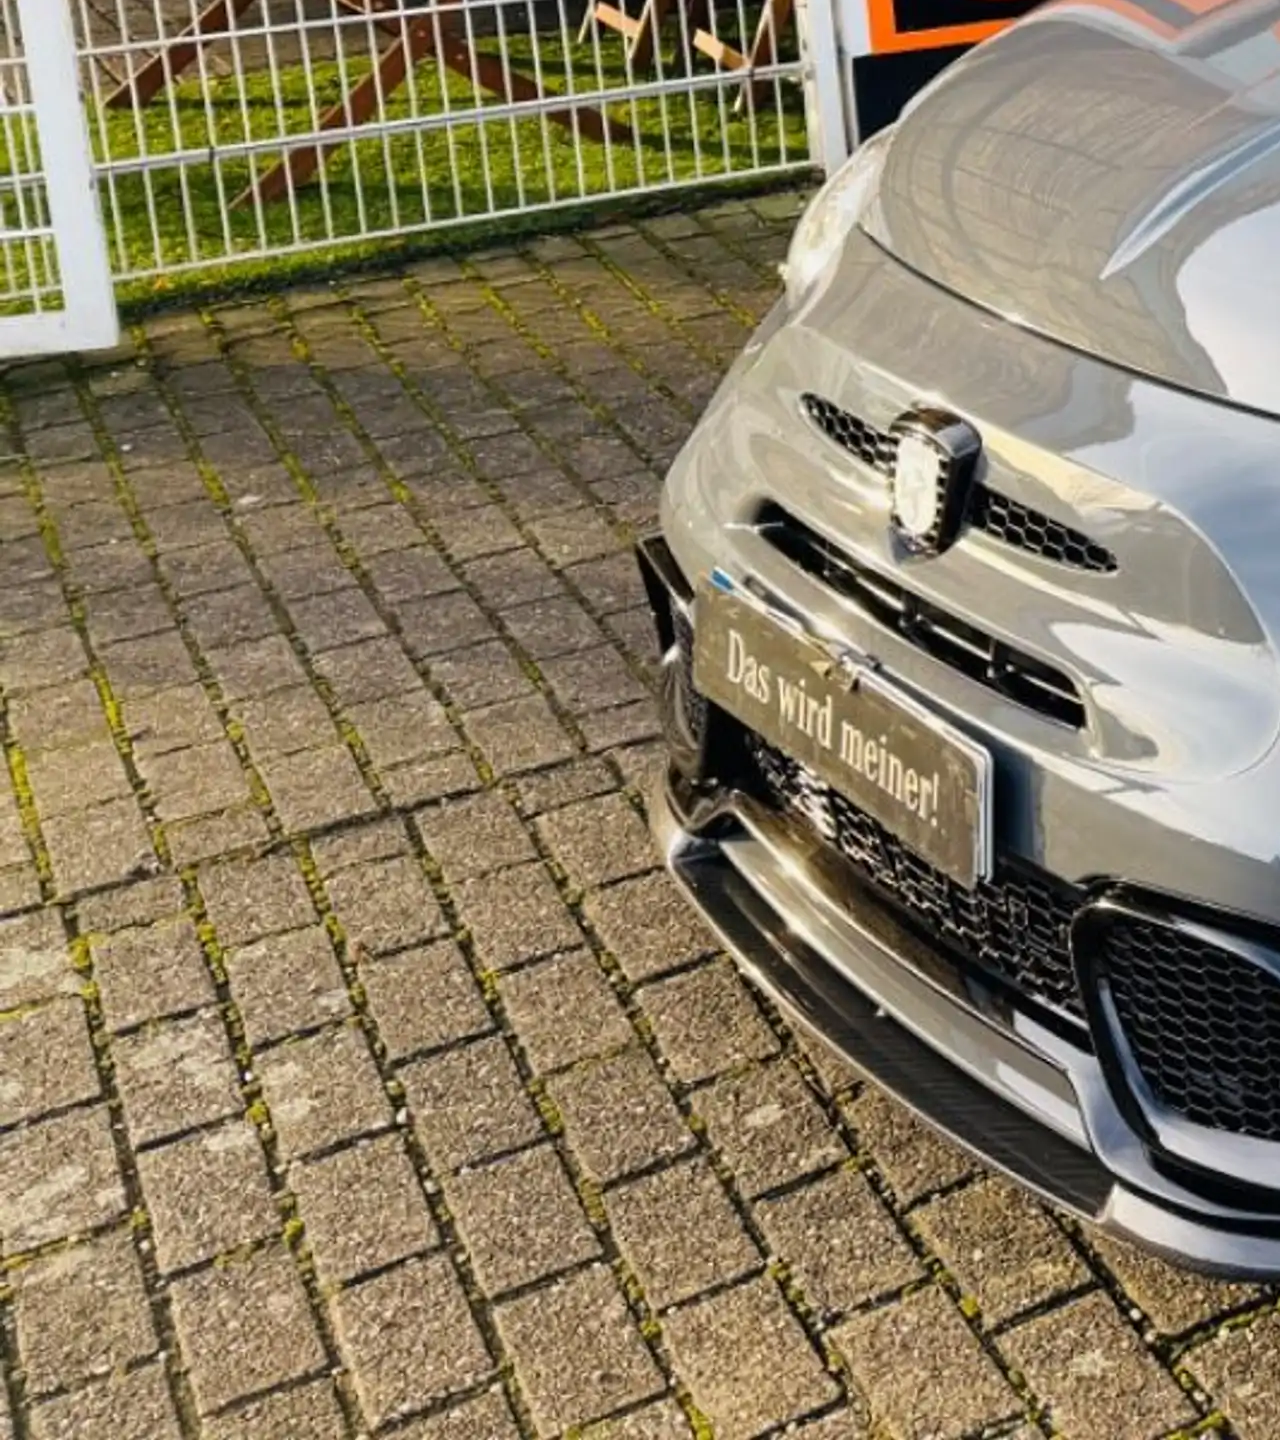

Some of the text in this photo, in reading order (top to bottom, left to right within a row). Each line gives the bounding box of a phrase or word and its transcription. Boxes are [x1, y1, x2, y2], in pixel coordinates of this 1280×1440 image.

[727, 629, 940, 828] Das wird meiner!
